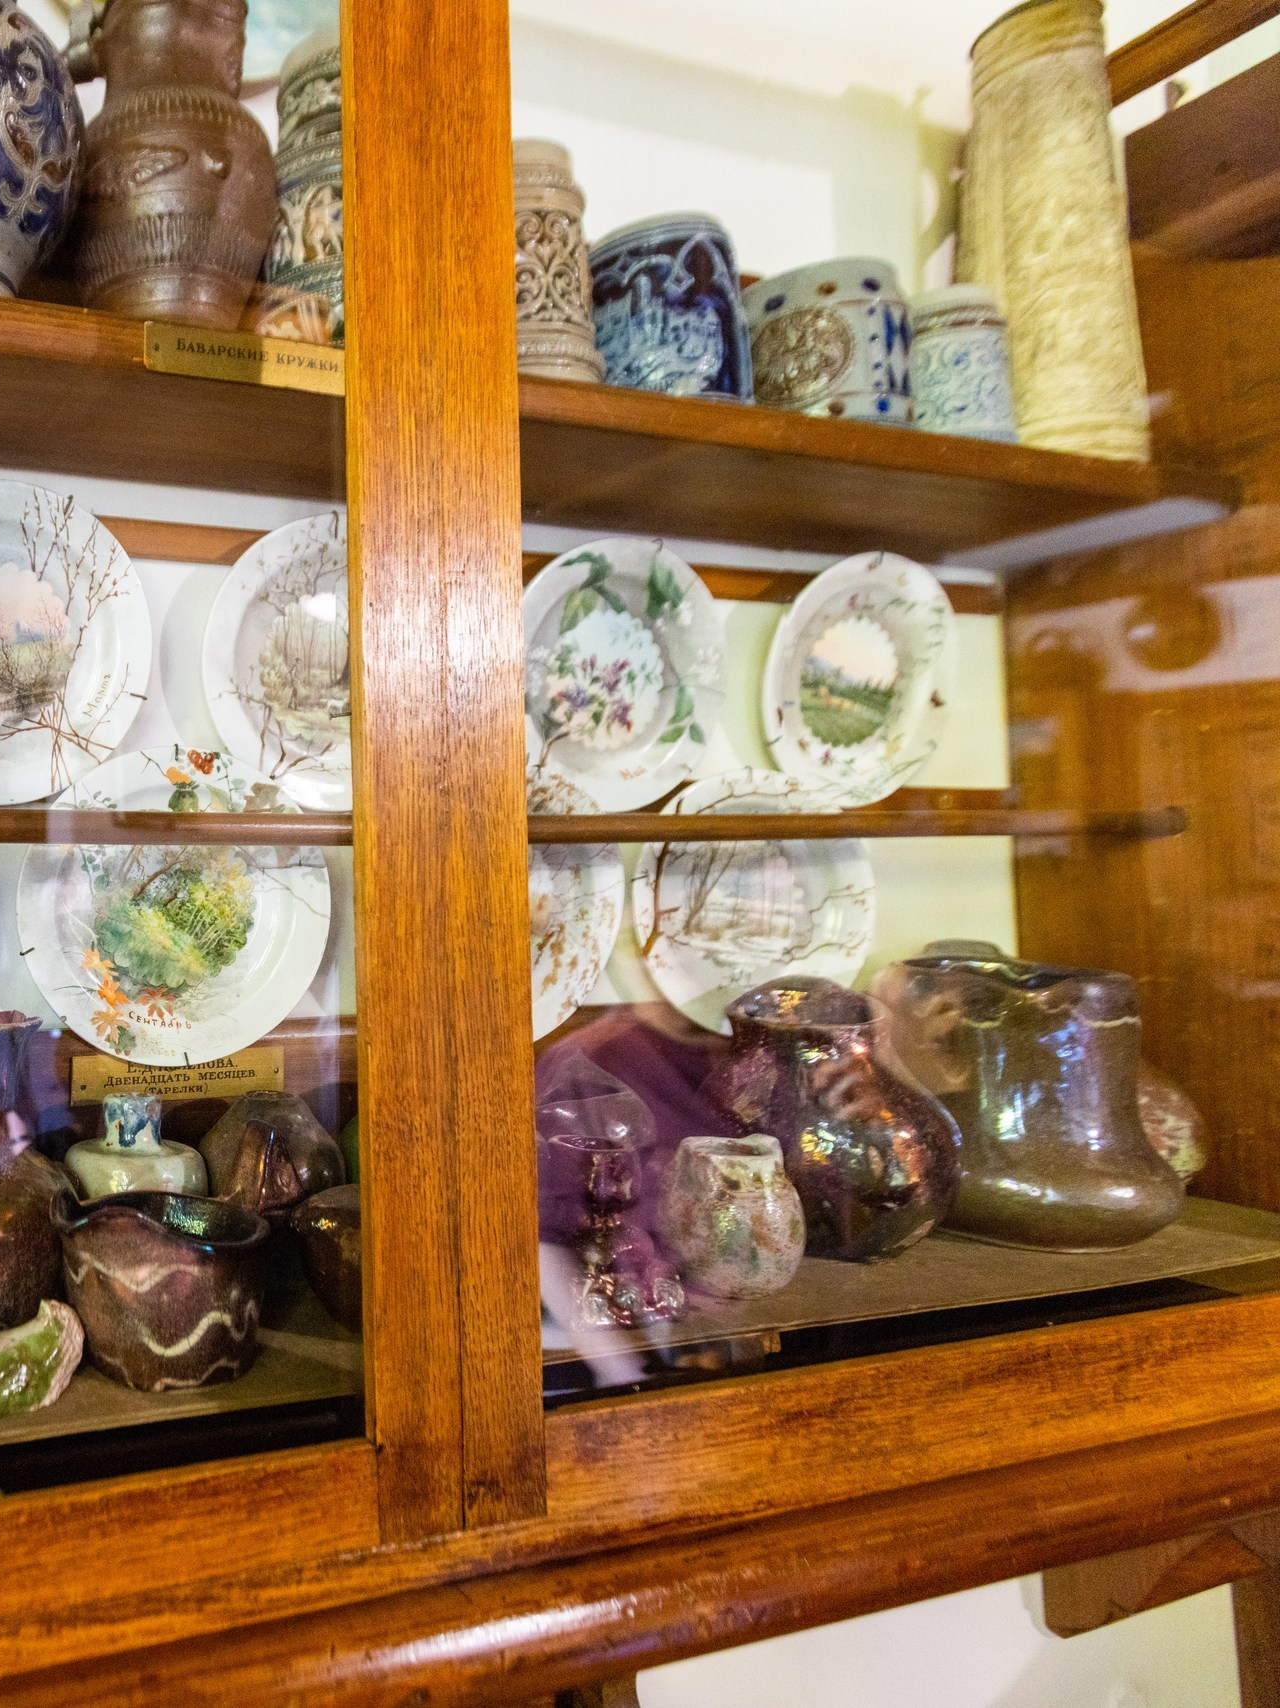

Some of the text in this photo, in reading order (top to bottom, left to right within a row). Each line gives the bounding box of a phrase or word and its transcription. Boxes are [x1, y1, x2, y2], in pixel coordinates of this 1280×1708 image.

[176, 338, 344, 373] БАВАРСКИЕ КРУЖКИ.
[104, 1073, 191, 1088] ДВЕНАДЦАТЬ
